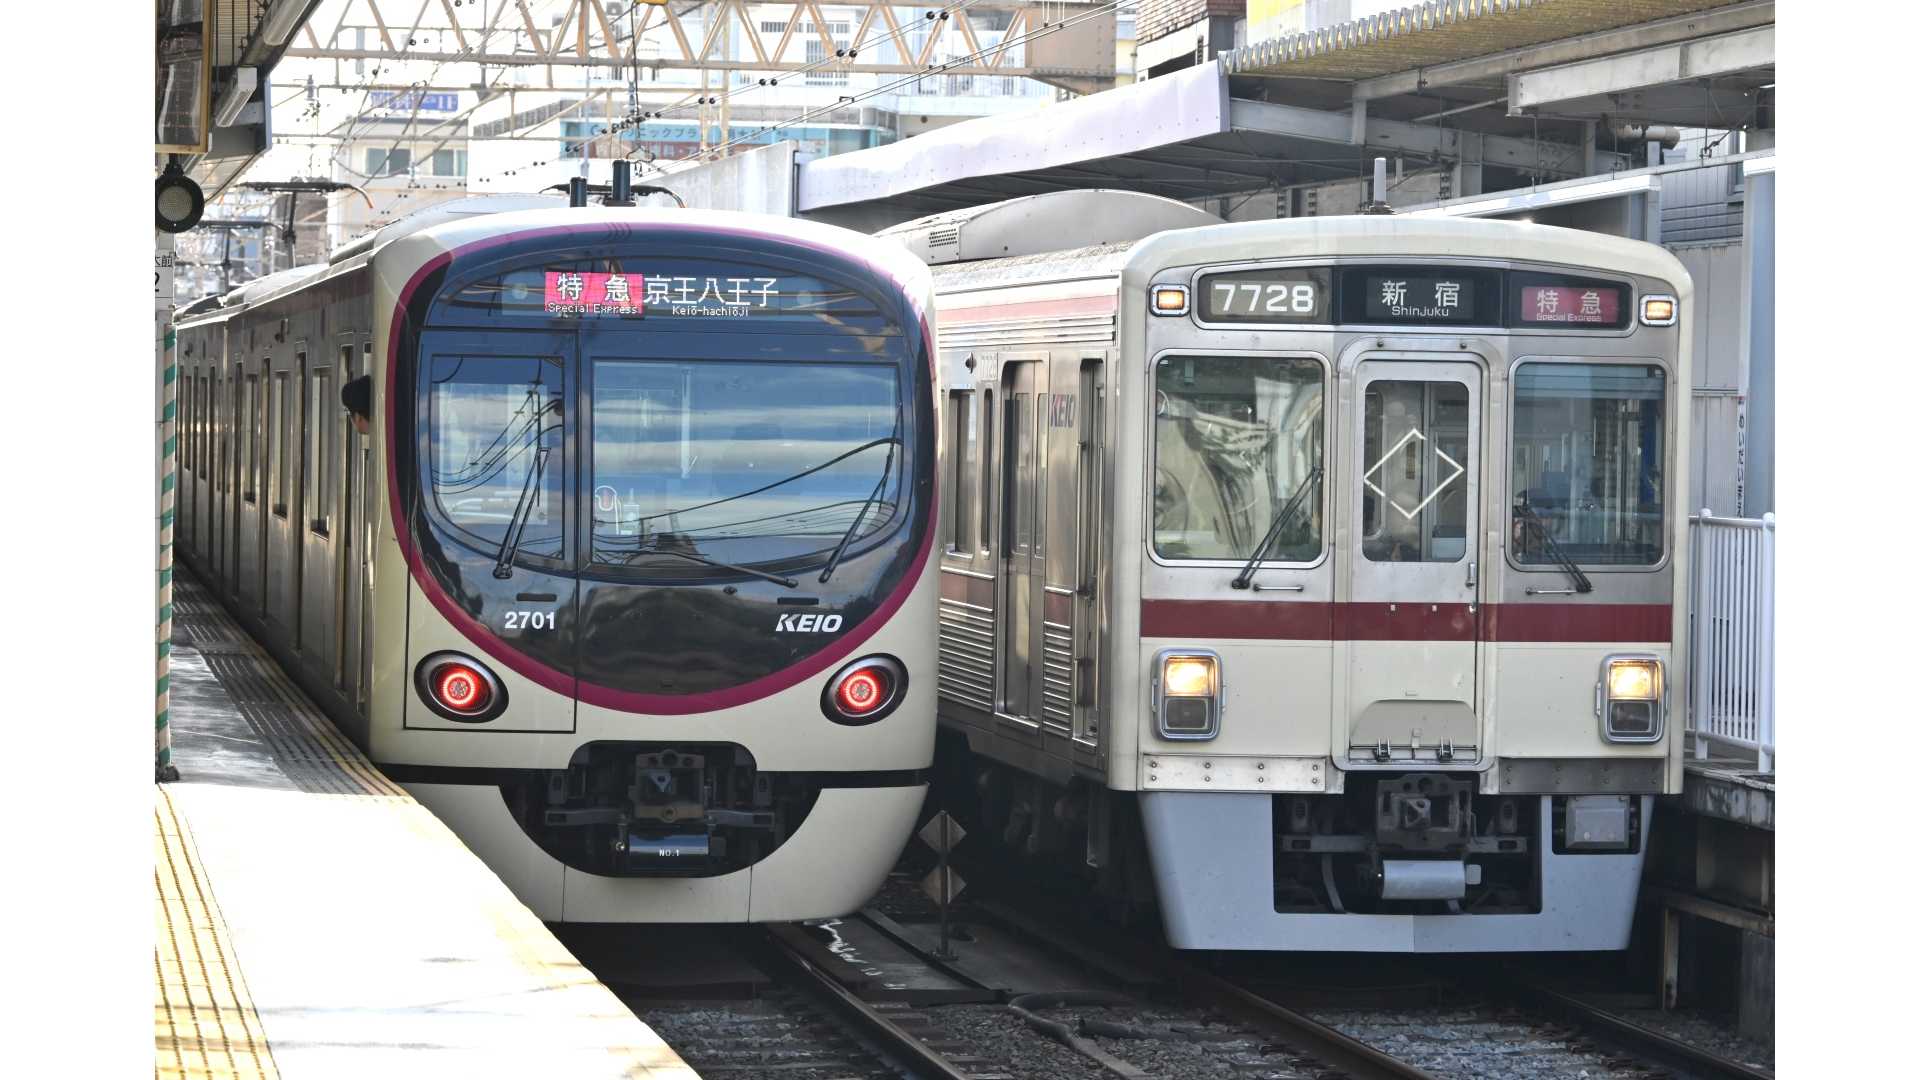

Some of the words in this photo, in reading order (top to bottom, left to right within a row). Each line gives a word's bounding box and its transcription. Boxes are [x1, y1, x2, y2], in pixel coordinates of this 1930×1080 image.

[557, 273, 630, 301] 特急
[643, 274, 779, 307] 京王八王子
[1214, 284, 1314, 312] 7728
[1381, 280, 1461, 308] 新宿
[548, 302, 590, 314] Special
[593, 303, 638, 315] Express
[1537, 289, 1601, 314] 特急
[1050, 393, 1077, 429] KEIO
[504, 611, 557, 629] 2701
[775, 613, 843, 633] KEIO
